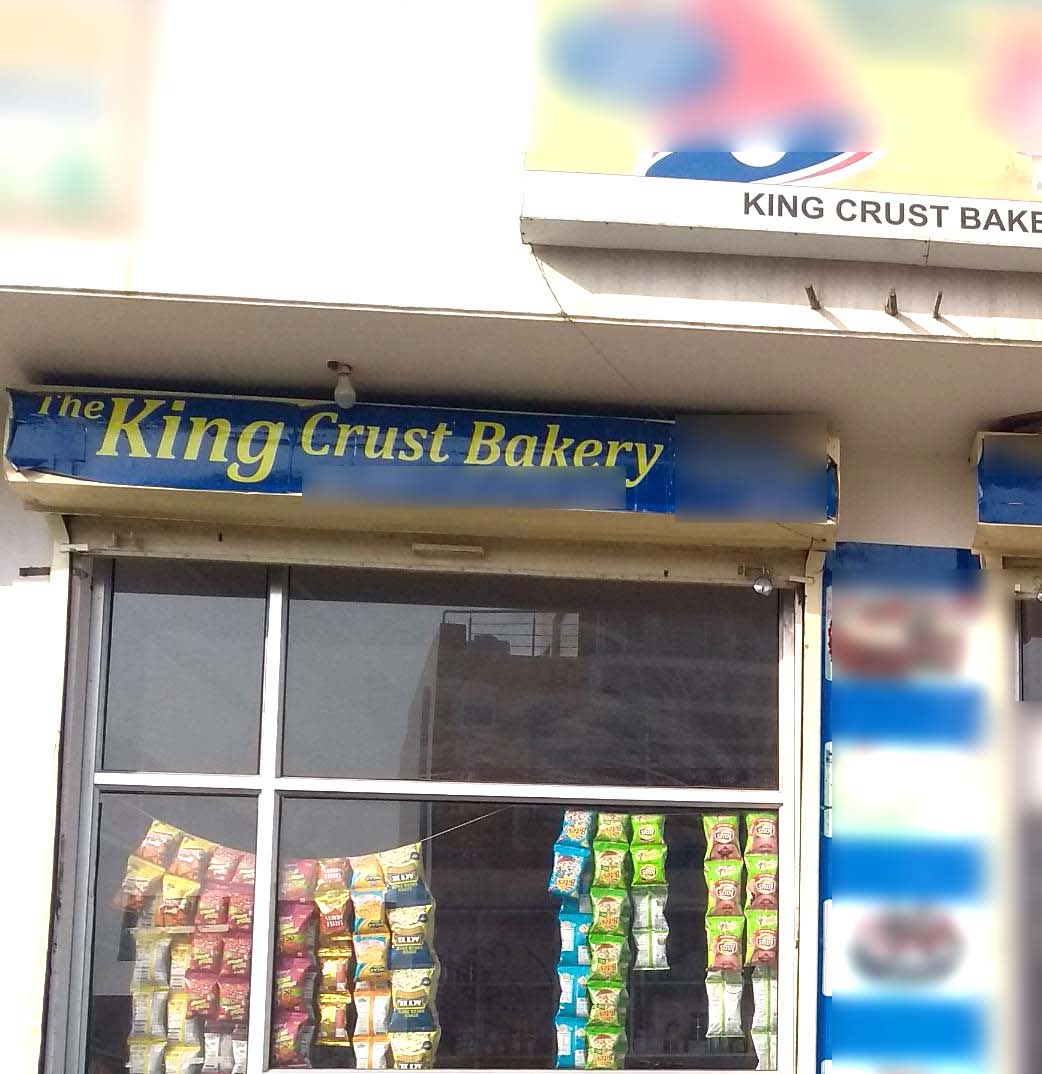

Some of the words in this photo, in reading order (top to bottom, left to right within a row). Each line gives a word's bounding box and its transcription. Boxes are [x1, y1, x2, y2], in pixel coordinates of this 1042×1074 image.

[743, 191, 825, 221] KING
[835, 198, 948, 230] CRUST
[37, 395, 105, 419] The
[96, 397, 284, 483] King
[301, 411, 452, 462] Crust
[464, 421, 664, 488] Bakery
